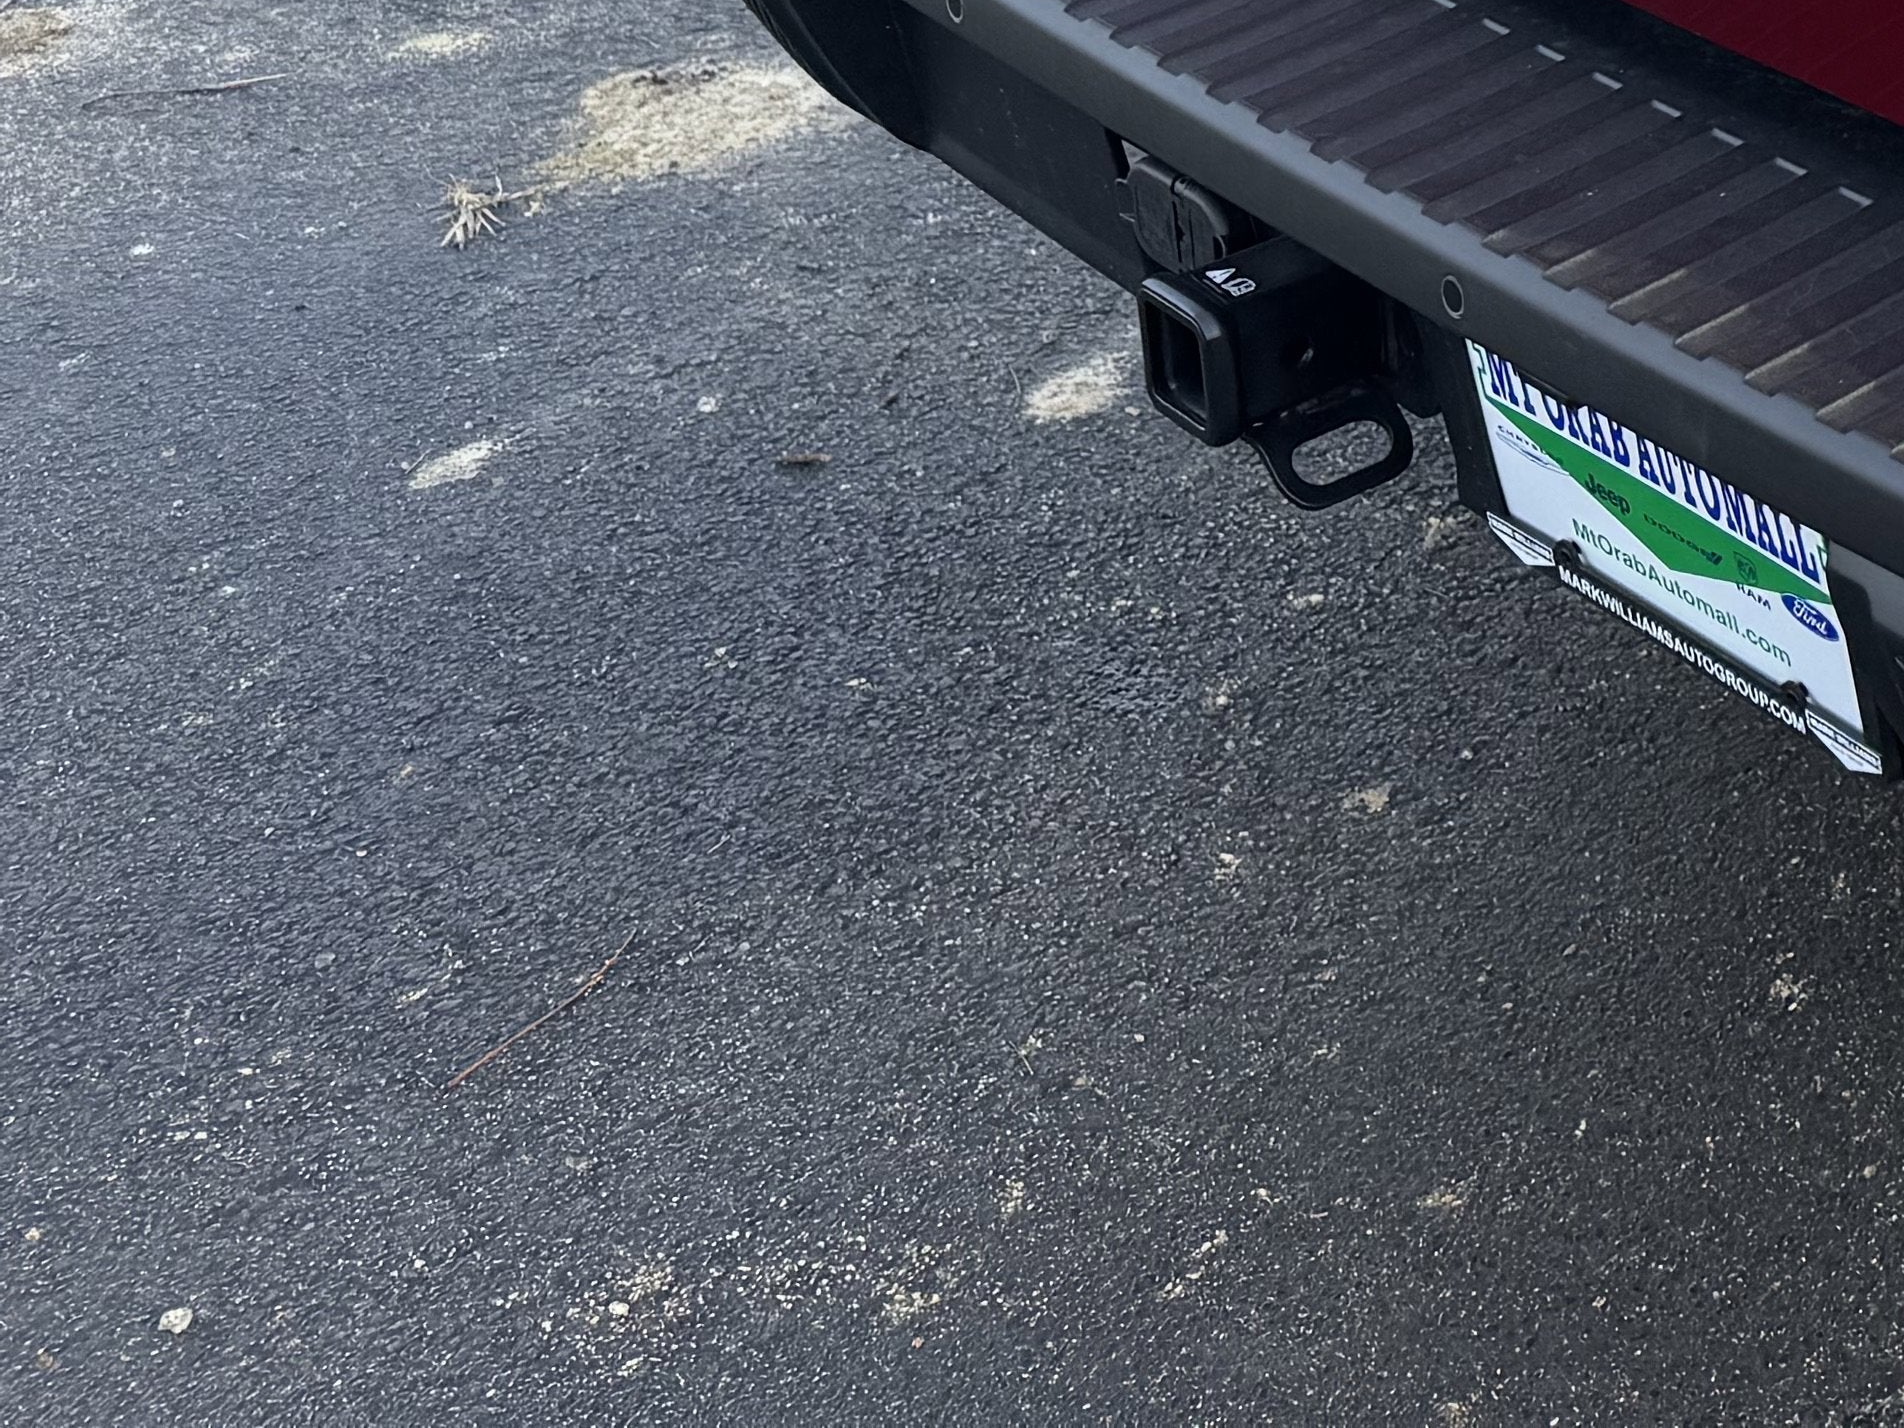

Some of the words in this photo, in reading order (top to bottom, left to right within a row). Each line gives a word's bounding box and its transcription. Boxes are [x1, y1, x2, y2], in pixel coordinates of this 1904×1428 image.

[1584, 473, 1631, 515] Jeep
[1638, 438, 1821, 584] AUTOMALL
[1572, 518, 1792, 667] MtOrabAutomall.com
[1793, 600, 1828, 635] Ford
